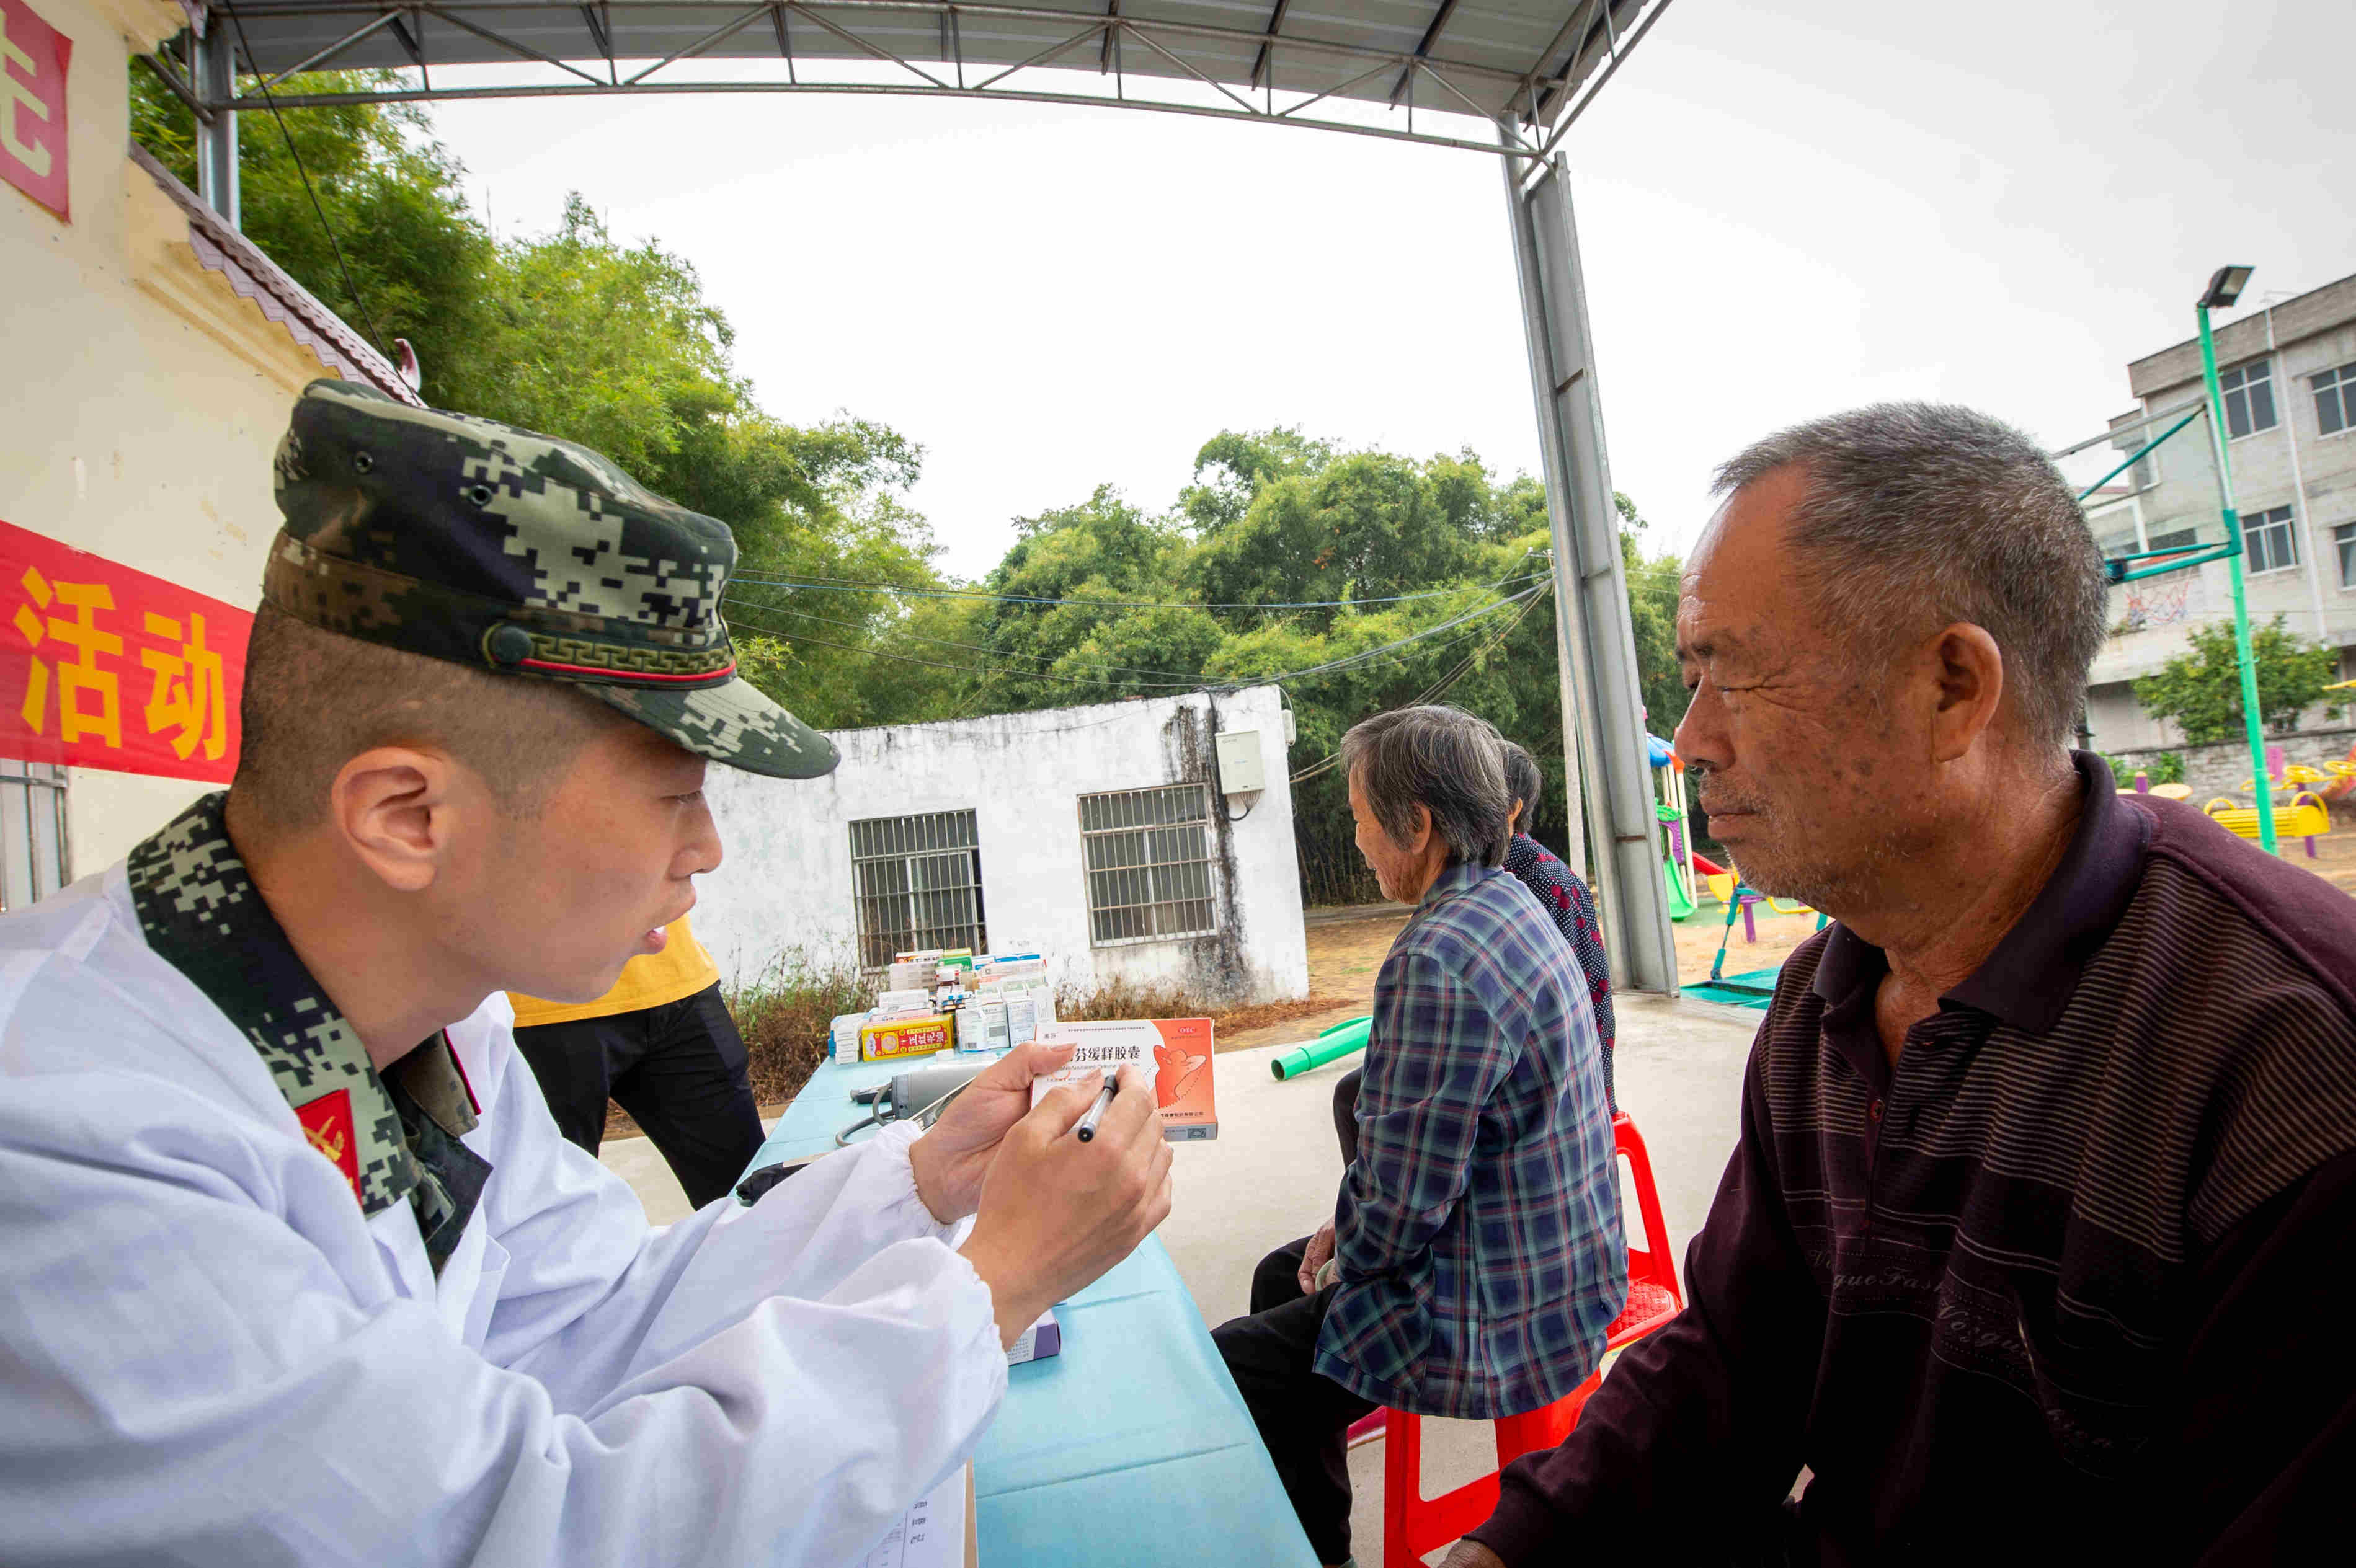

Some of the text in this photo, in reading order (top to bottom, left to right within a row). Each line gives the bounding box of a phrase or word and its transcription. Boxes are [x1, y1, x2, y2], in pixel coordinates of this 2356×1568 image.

[13, 565, 226, 761] 活动
[1071, 1045, 1141, 1062] 芬缓释胶囊
